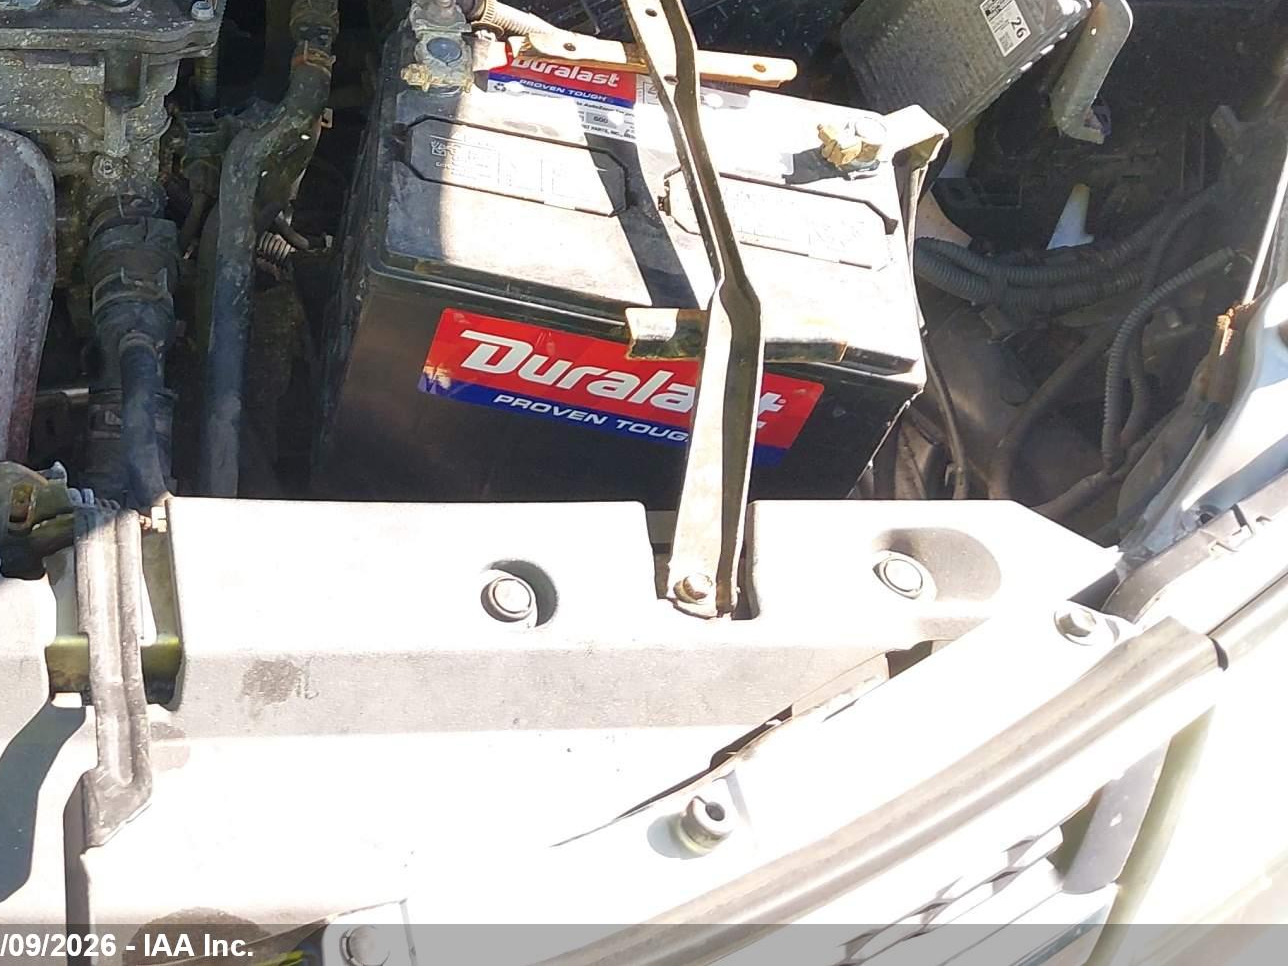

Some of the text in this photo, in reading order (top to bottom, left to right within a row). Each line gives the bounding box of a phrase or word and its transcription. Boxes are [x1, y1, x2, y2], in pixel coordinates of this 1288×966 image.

[1010, 17, 1027, 39] 26
[510, 58, 620, 88] Duralast
[518, 78, 608, 102] PROVEN TOUGH
[492, 393, 690, 444] PROVEN TOUG
